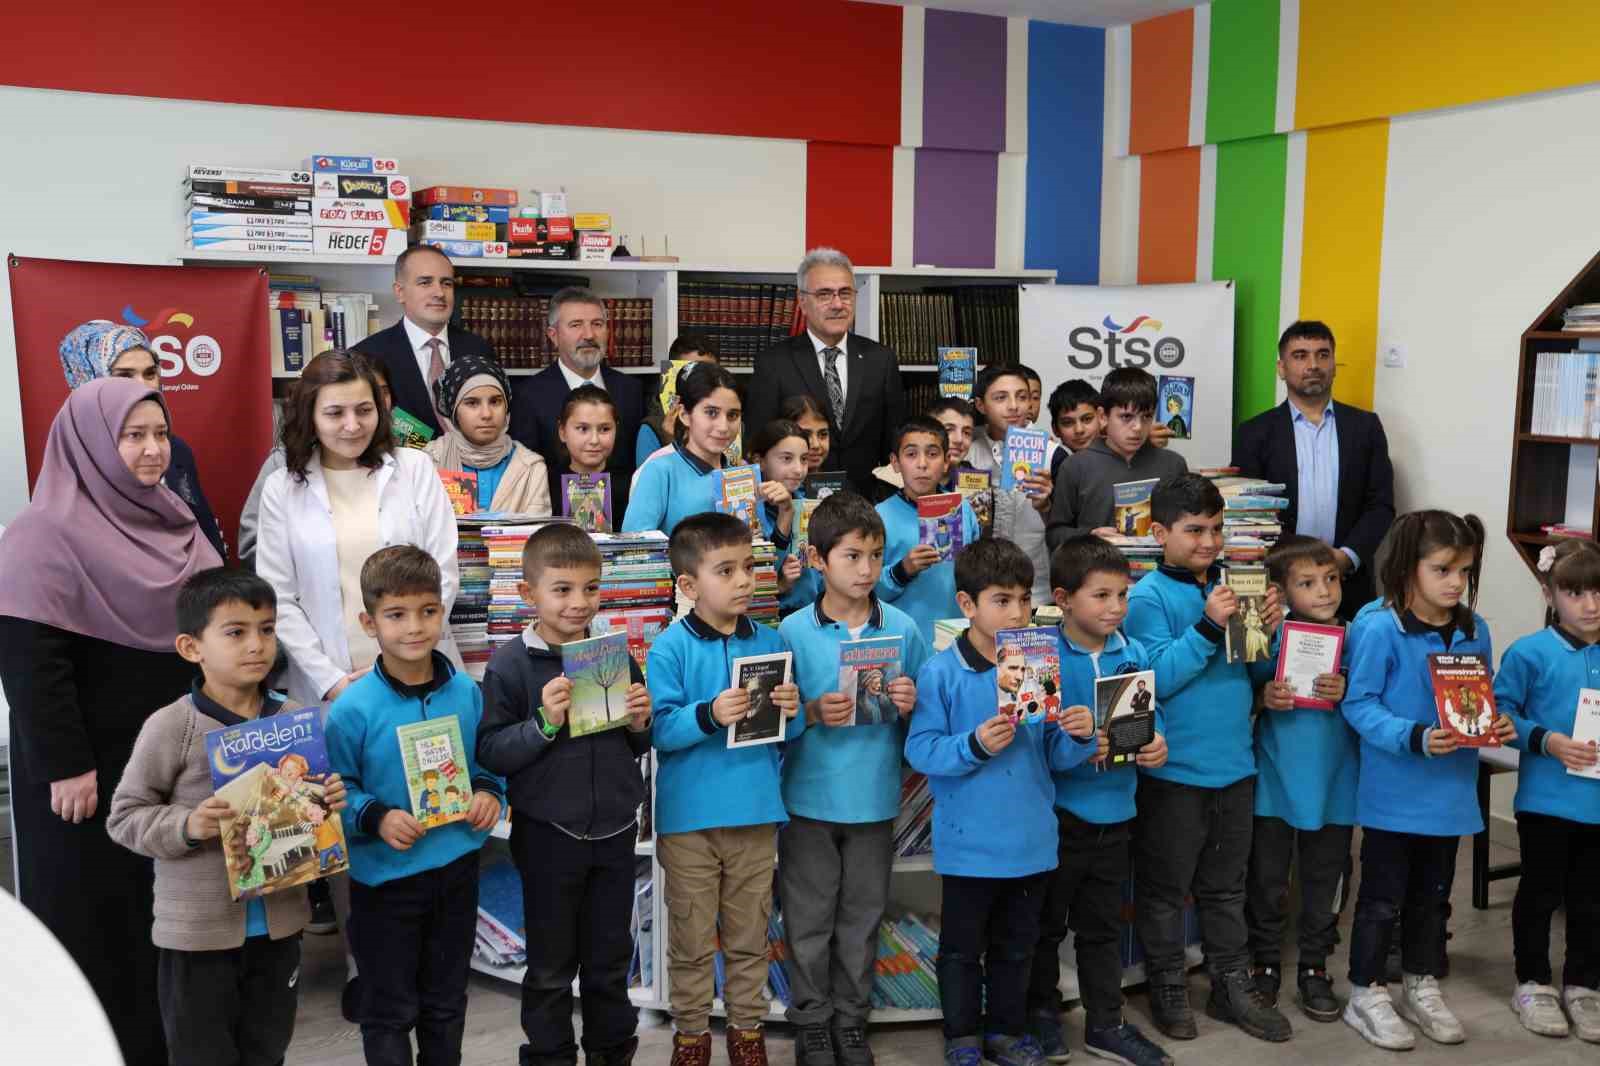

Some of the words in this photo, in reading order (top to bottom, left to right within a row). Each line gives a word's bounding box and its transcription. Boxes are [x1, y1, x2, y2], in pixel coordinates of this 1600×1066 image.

[328, 234, 368, 249] HEDEF
[371, 236, 384, 251] 5
[219, 721, 305, 758] kardelen
